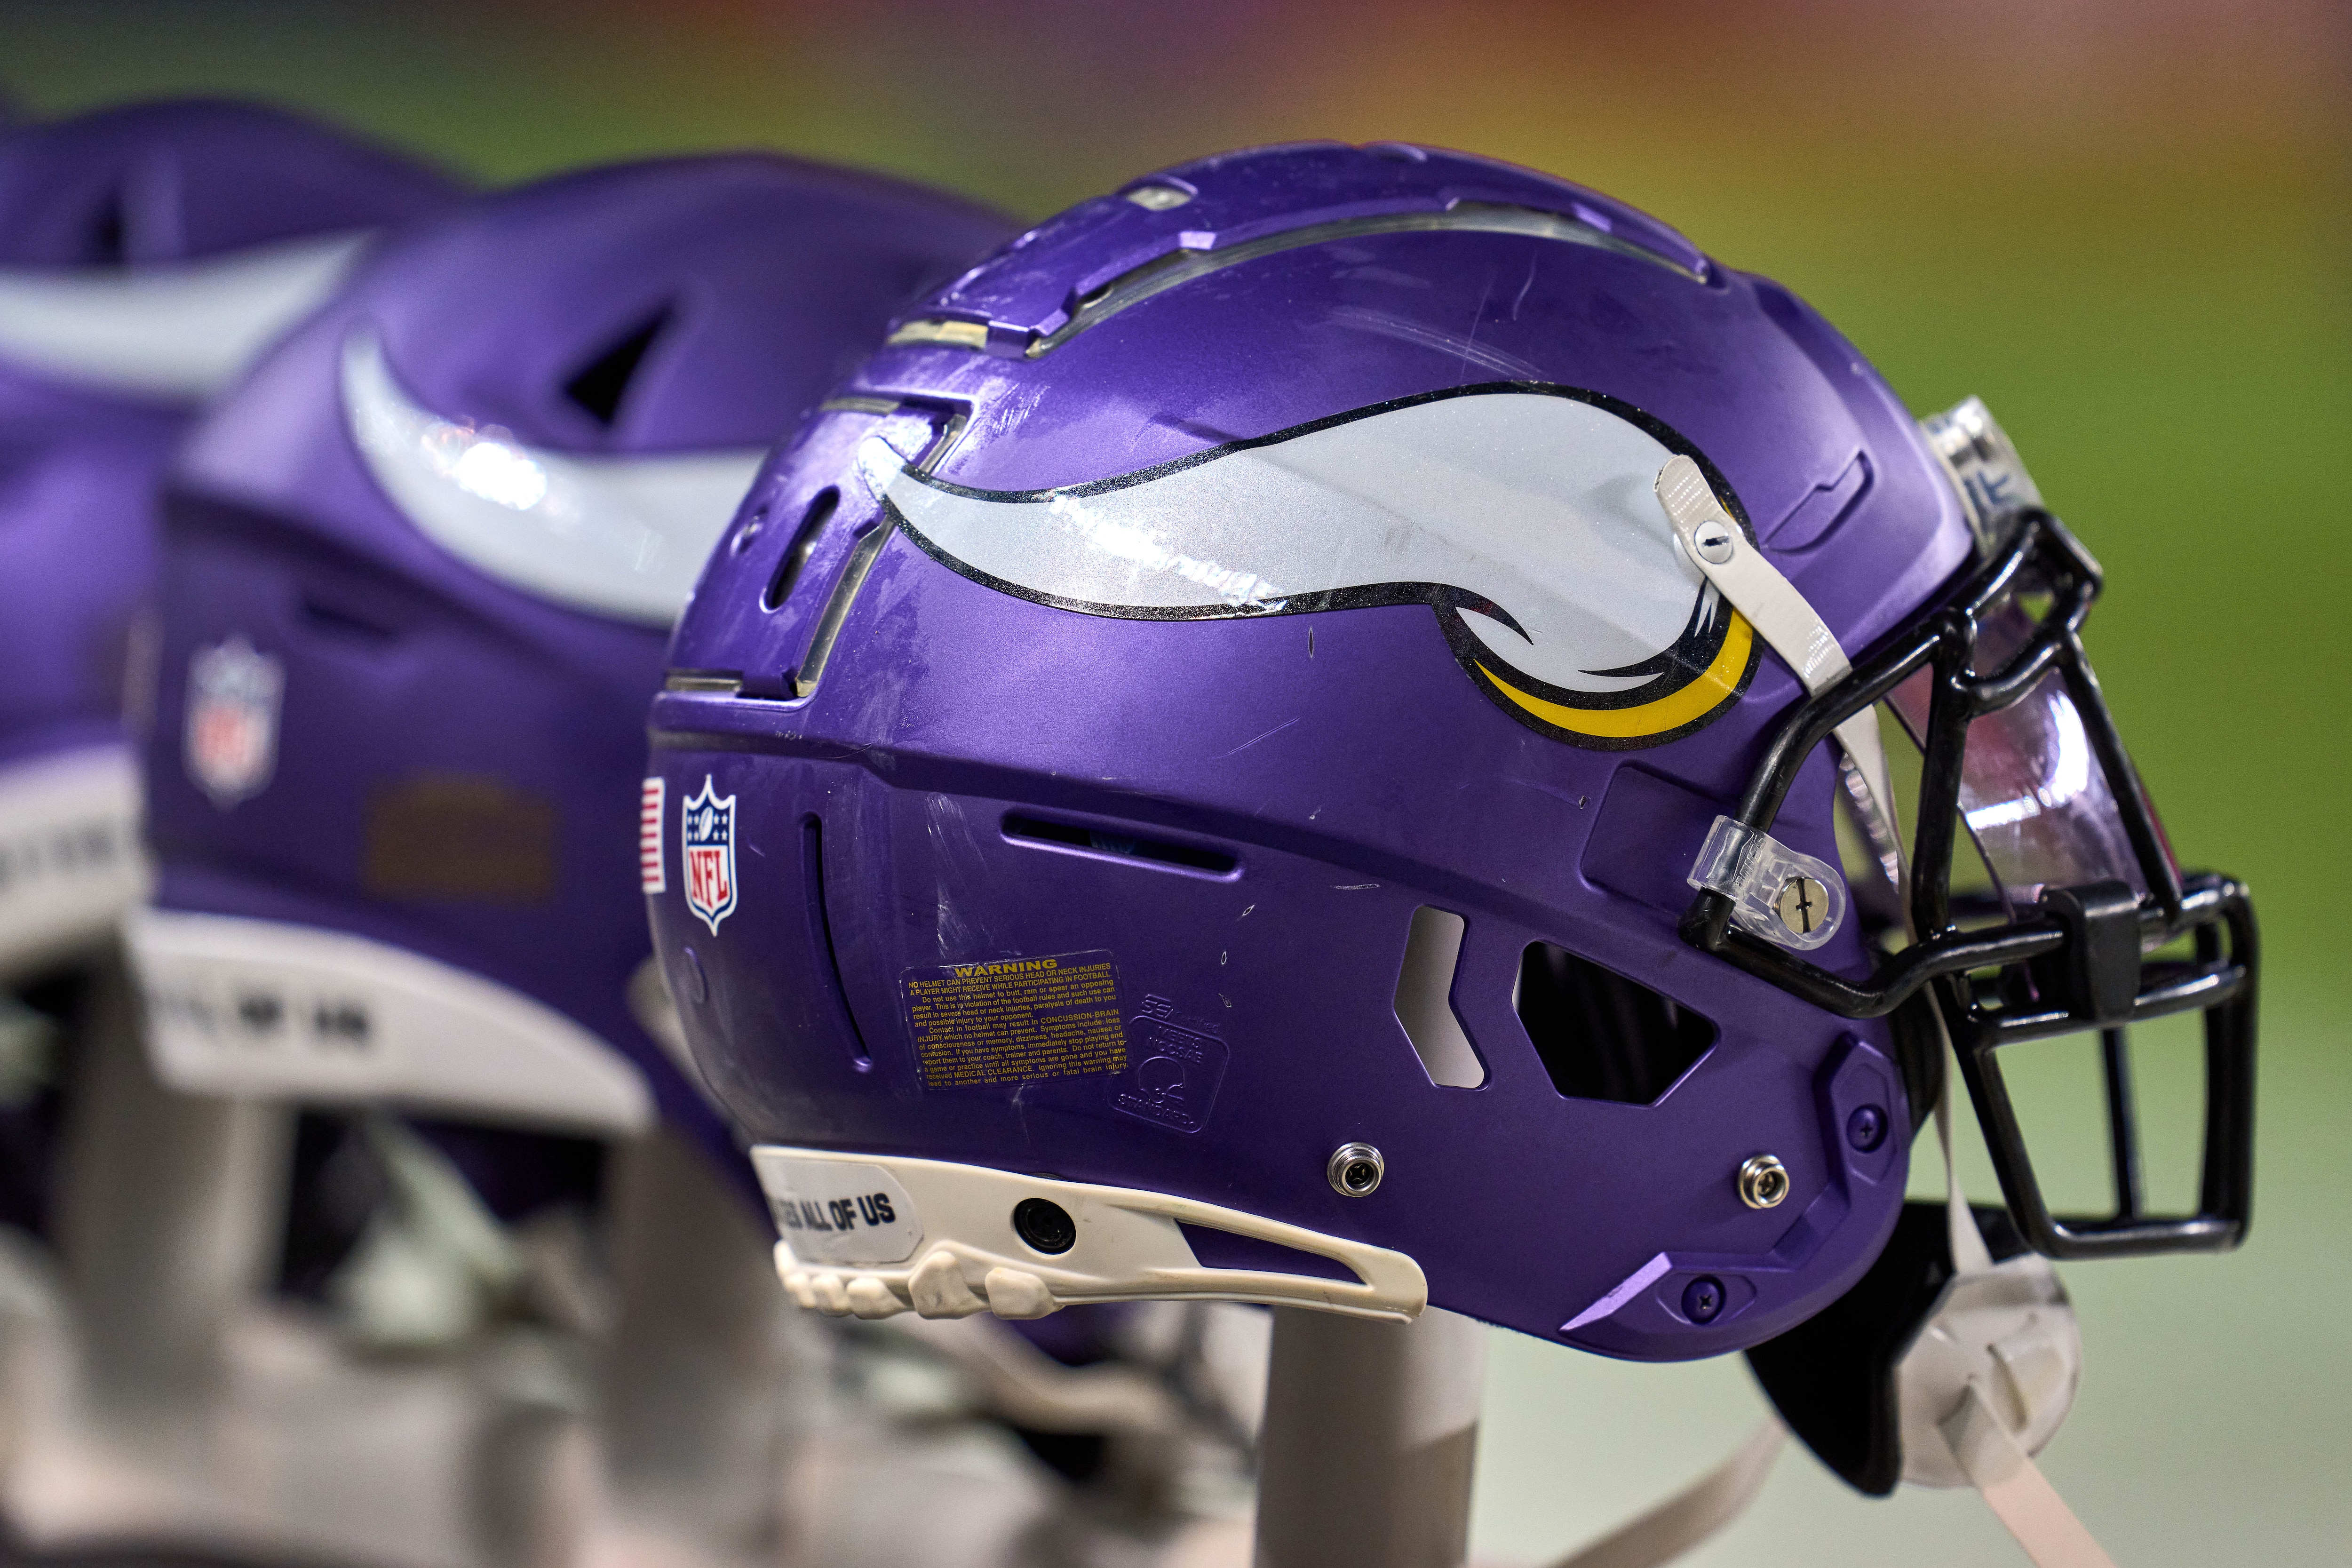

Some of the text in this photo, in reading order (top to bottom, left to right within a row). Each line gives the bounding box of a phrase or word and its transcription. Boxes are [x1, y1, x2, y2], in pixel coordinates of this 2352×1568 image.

[690, 850, 728, 908] NFL
[954, 959, 1057, 978] WARNING
[961, 976, 992, 985] PREVENT
[993, 973, 1024, 982] SERIOUS
[1025, 971, 1045, 979] HEAD
[1057, 967, 1077, 975] NECK
[1079, 963, 1111, 973] INJURIES
[962, 984, 990, 992] RECEIVE
[1013, 976, 1064, 987] PARTICIPATING
[1081, 979, 1113, 989] opposing
[1005, 1004, 1032, 1012] injuries,
[1033, 1000, 1064, 1010] paralysis
[928, 1018, 955, 1027] possible
[1000, 1011, 1033, 1020] opponent.
[1040, 1009, 1119, 1023] CONCUSSION-BRAIN
[1040, 1023, 1076, 1032] Symptoms
[927, 1041, 975, 1049] consciousness
[991, 1043, 1026, 1053] symptoms,
[1027, 1039, 1067, 1048] immediately
[1084, 1034, 1109, 1043] playing
[954, 1069, 985, 1078] MEDICAL
[1038, 1062, 1067, 1071] Ignoring
[1083, 1057, 1111, 1066] warning
[1011, 1057, 1046, 1066] symptoms
[1022, 1071, 1048, 1079] serious
[828, 1198, 858, 1232] OF
[857, 1192, 896, 1226] US
